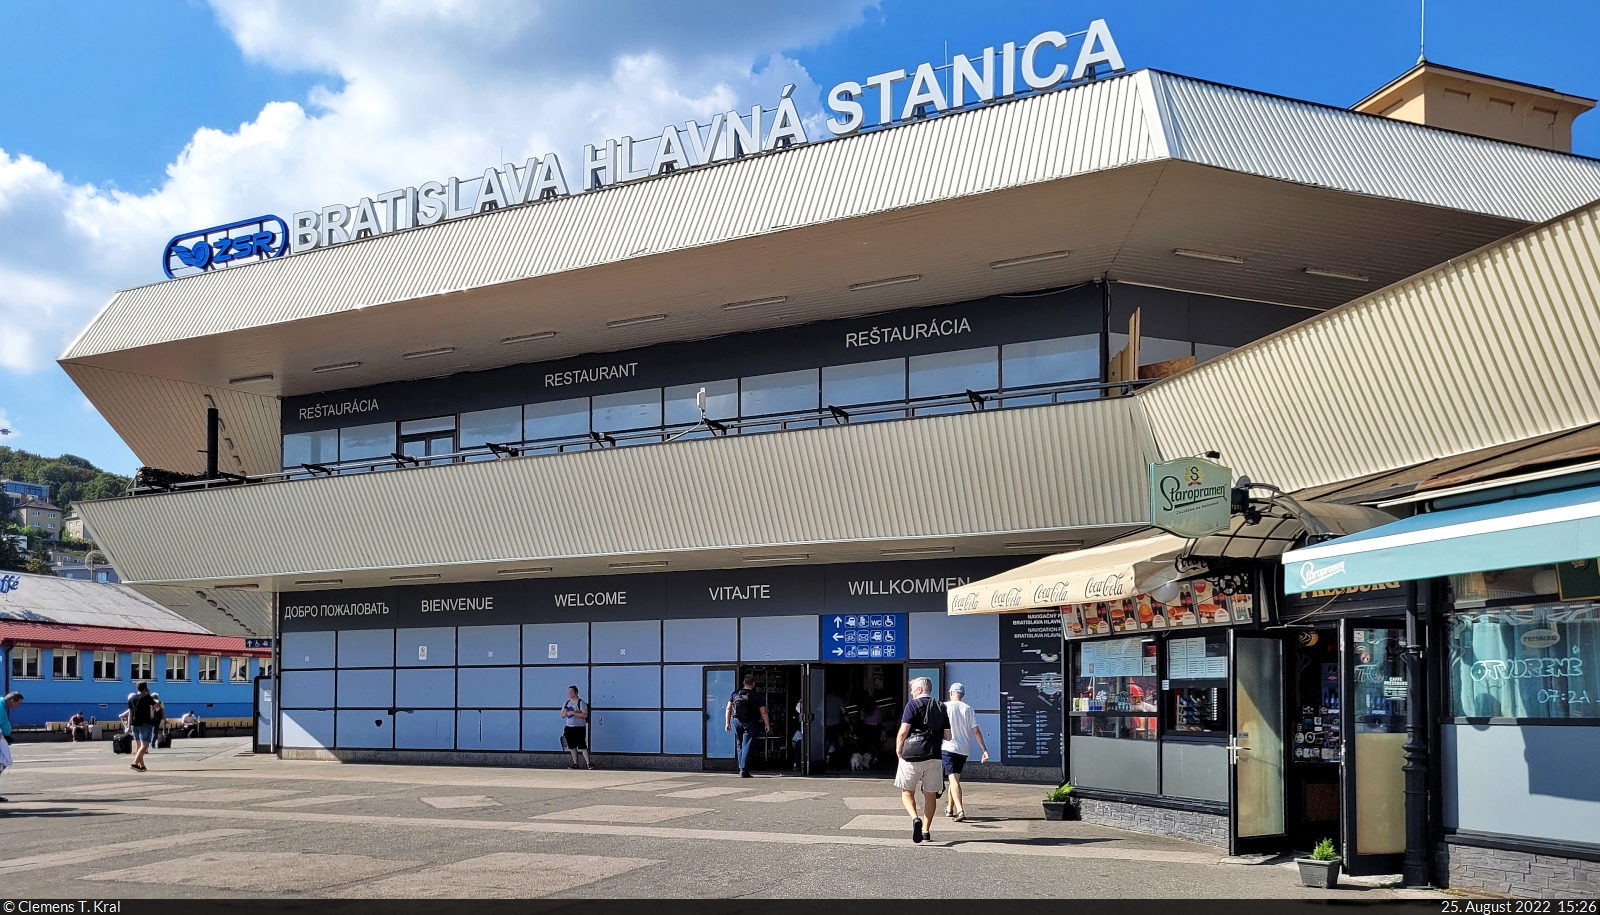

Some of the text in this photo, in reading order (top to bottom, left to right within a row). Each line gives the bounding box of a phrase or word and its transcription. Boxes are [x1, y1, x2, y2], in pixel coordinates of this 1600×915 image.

[293, 18, 1125, 253] BRATISLAVA HLAVNÁ STANICA
[846, 318, 971, 348] REŠTAURÁCIA
[544, 362, 638, 388] RESTAURANT
[299, 398, 380, 421] REŠTAURÁCIA
[1160, 476, 1227, 511] Staropramen
[0, 574, 21, 593] ffé
[1300, 561, 1346, 589] Staropramen
[554, 591, 627, 607] WELCOME
[709, 585, 771, 601] VITAJTE
[284, 602, 390, 620] ДОБРО ПОЖАЛОВАТЬ
[421, 597, 494, 613] BIENVENUE
